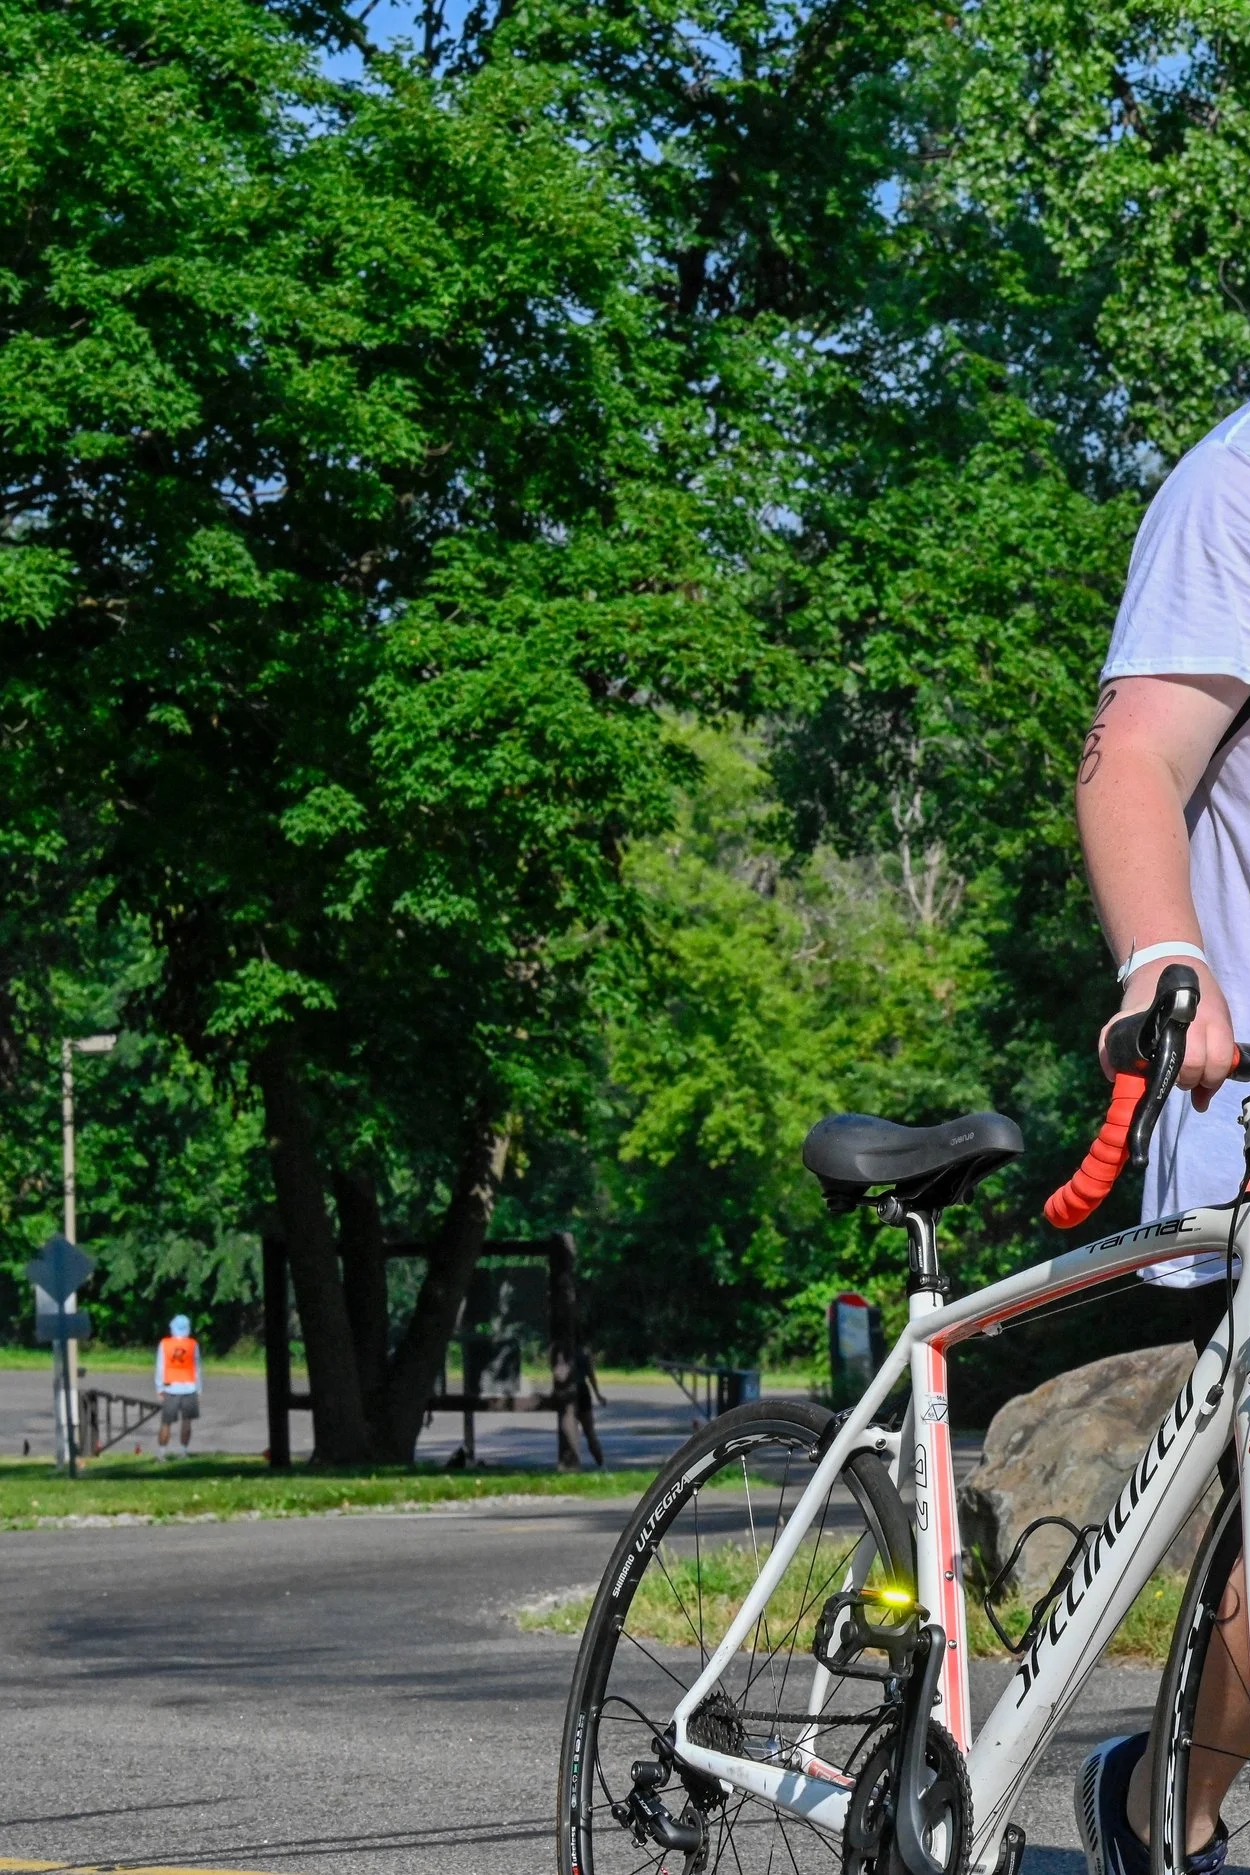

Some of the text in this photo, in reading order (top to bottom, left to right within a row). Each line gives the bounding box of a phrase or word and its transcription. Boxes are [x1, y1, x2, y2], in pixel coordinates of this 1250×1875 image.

[1156, 1051, 1178, 1100] ULTEGRA
[611, 1474, 690, 1599] SHIMANO ULTEGRA
